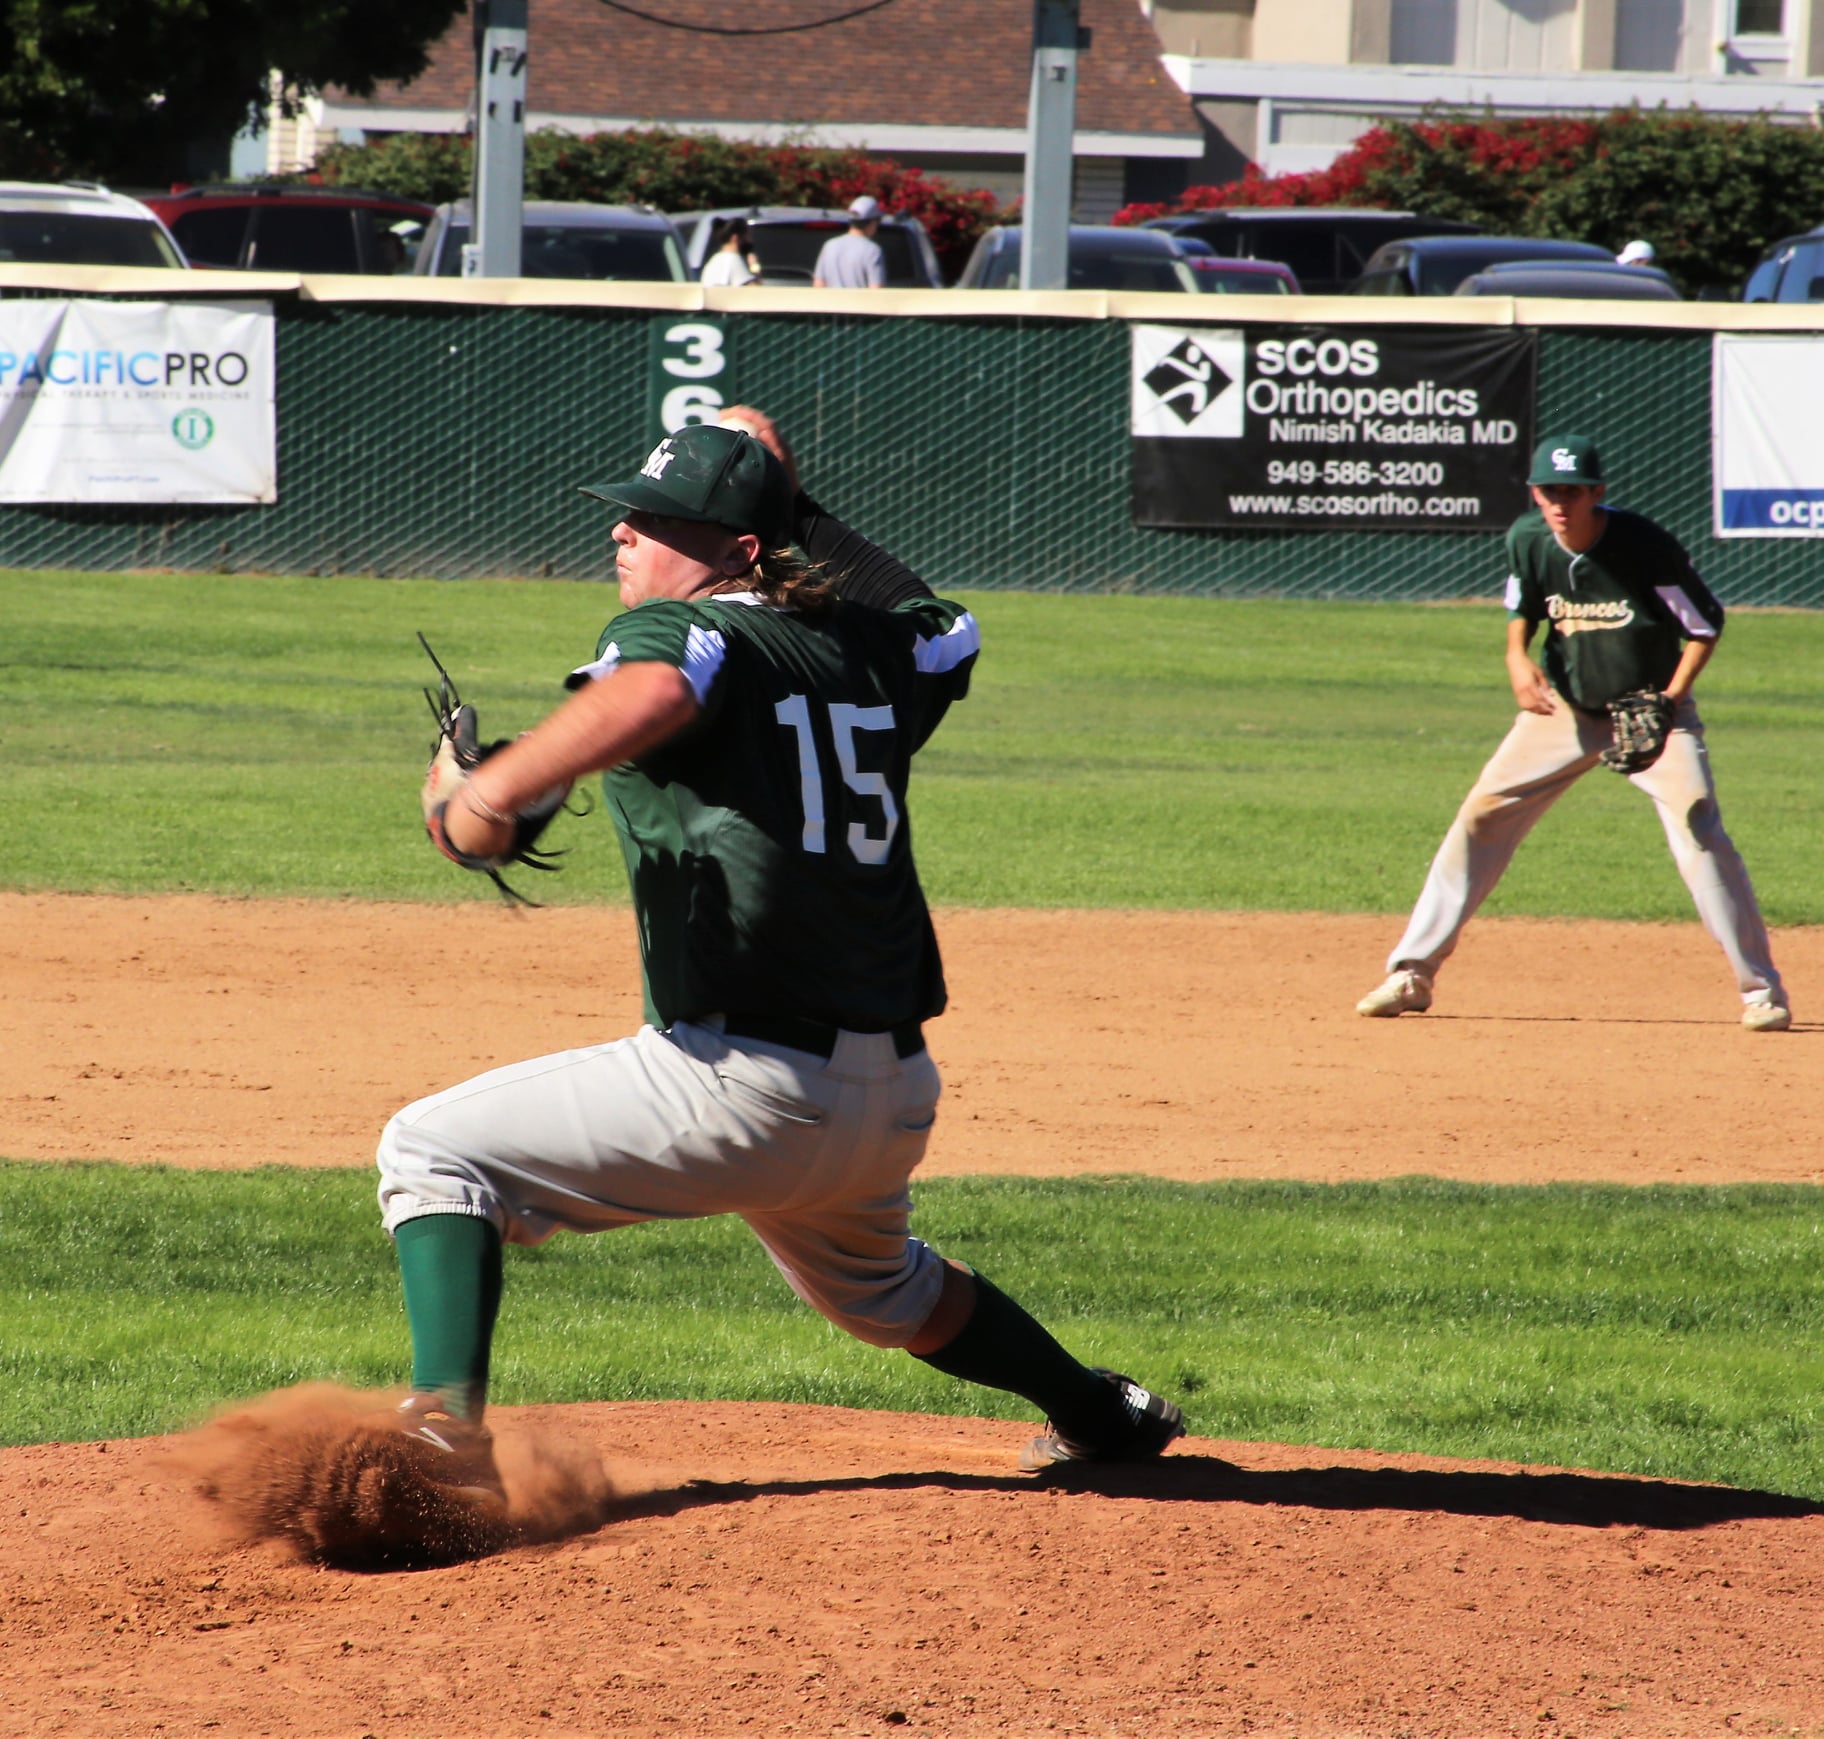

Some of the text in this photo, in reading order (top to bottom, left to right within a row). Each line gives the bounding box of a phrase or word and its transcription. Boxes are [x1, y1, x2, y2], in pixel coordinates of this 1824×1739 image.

[0, 351, 248, 386] PACIFICPRO
[1256, 338, 1379, 376] SCOS
[1246, 378, 1479, 422] Orthopedics
[1269, 418, 1518, 444] Nimish Kadakia MD
[1267, 460, 1443, 485] 949-586-3200
[1229, 492, 1480, 516] www.scosortho.com
[774, 693, 899, 865] 15
